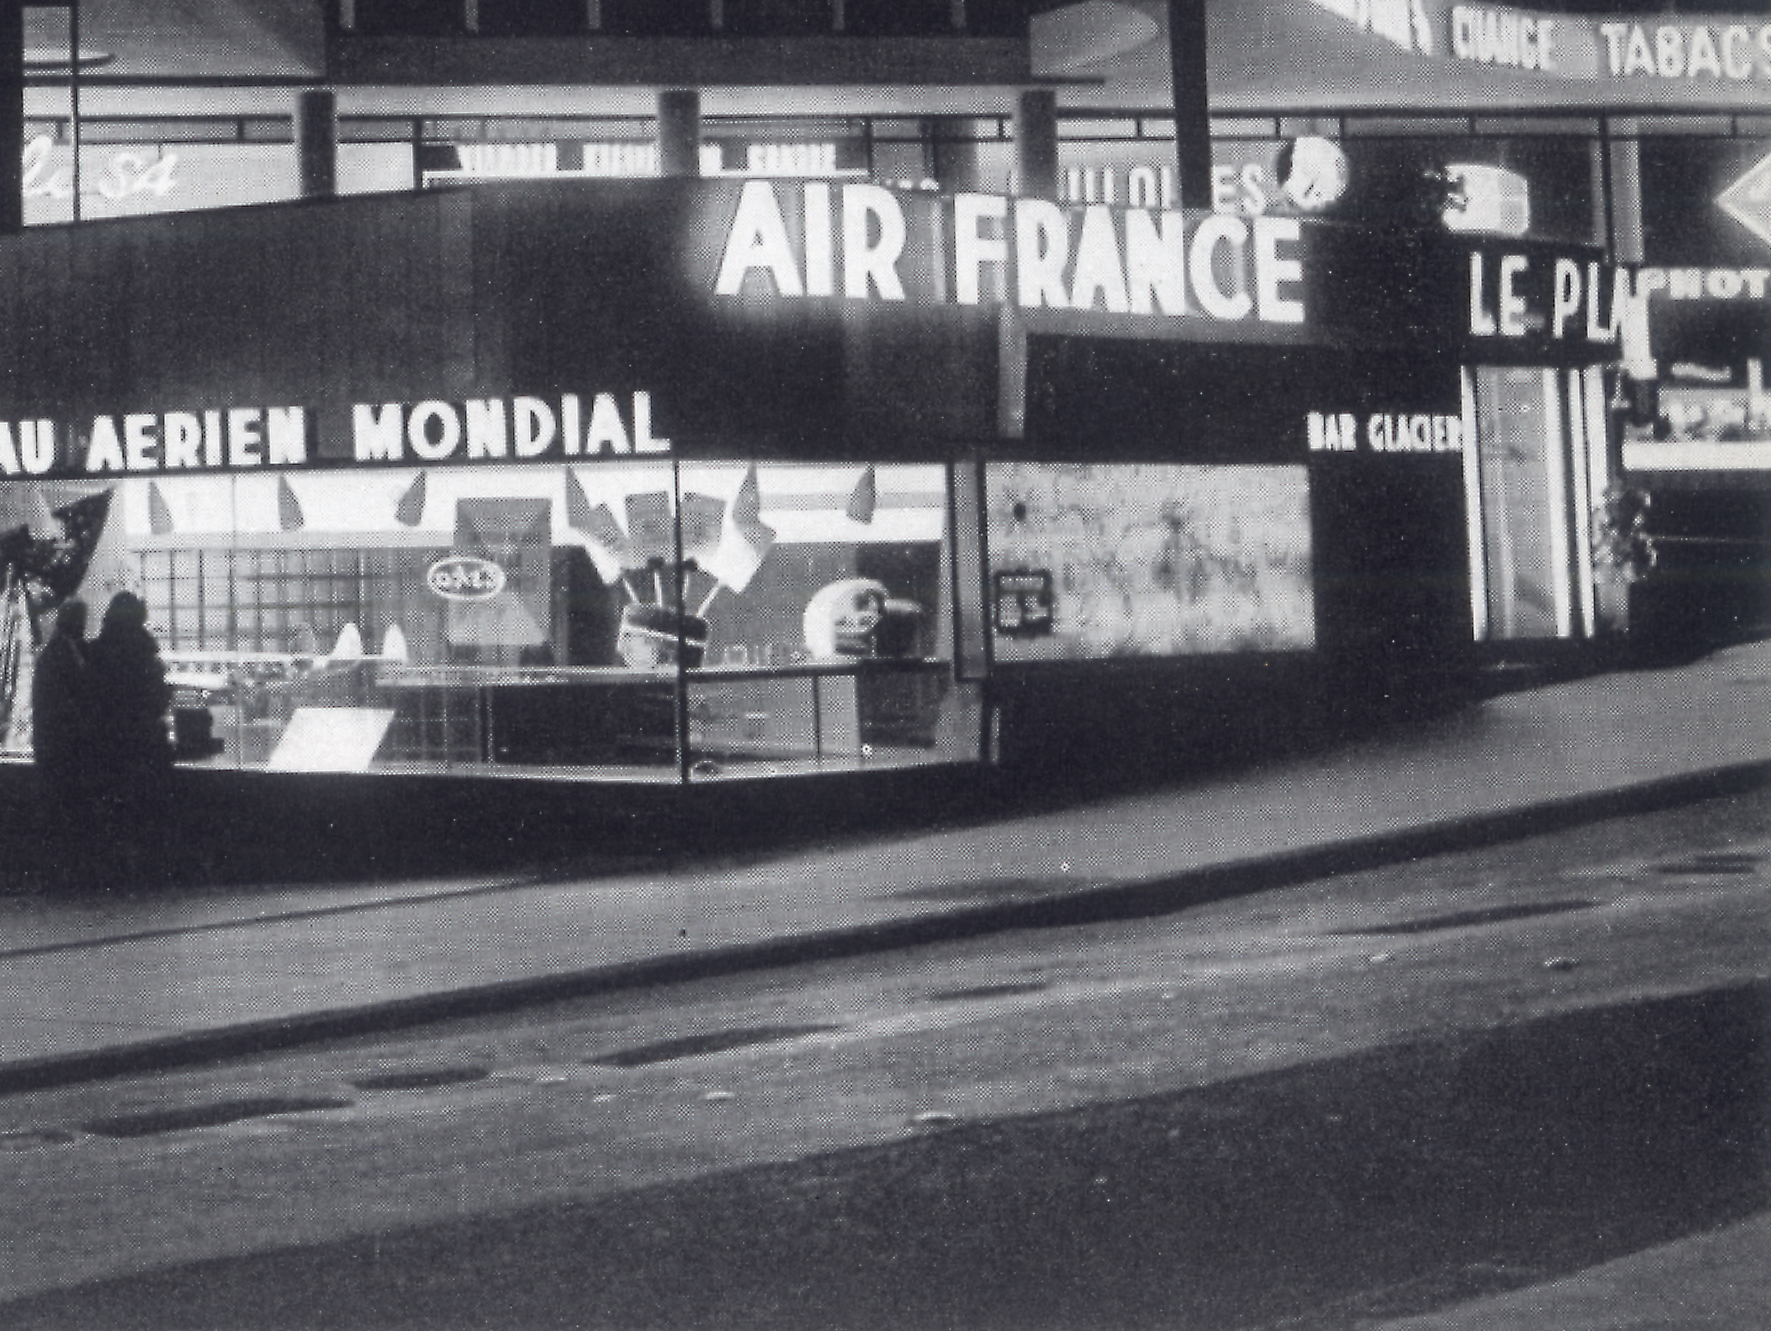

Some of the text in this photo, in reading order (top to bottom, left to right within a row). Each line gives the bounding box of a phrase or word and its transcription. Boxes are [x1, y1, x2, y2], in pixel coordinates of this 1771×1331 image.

[1451, 5, 1555, 71] CHANGE
[714, 181, 906, 301] AIR
[953, 191, 1305, 323] FRANCE
[1470, 251, 1528, 337] LE
[85, 405, 308, 470] AERIEN
[351, 390, 672, 461] MONDIAL
[1307, 412, 1357, 451] BAR
